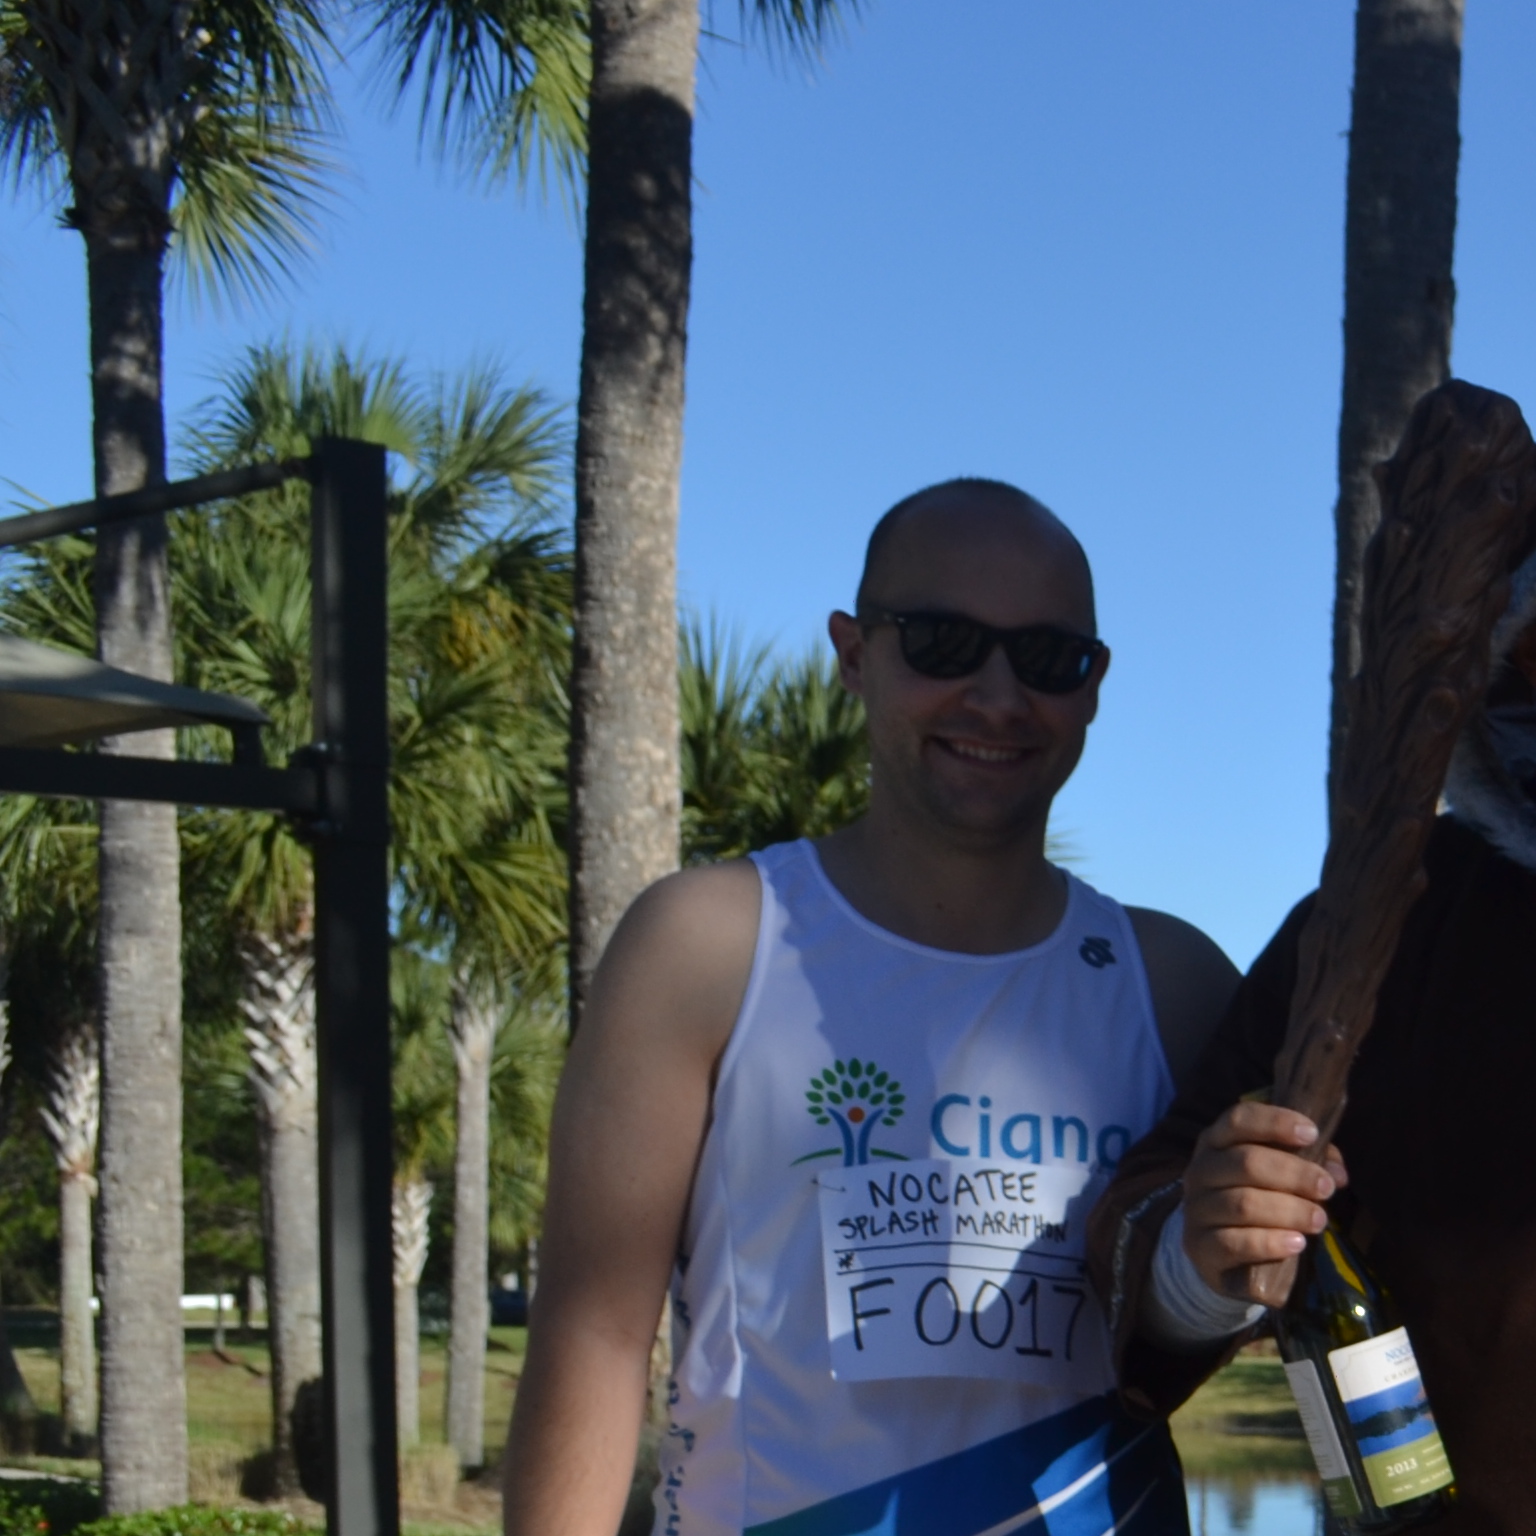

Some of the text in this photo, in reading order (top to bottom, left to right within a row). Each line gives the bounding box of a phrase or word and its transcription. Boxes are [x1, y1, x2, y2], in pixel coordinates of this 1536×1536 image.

[868, 1169, 1037, 1208] NOCATEE
[838, 1208, 1068, 1243] SPLASH MARATHON
[1385, 1457, 1419, 1478] 2013
